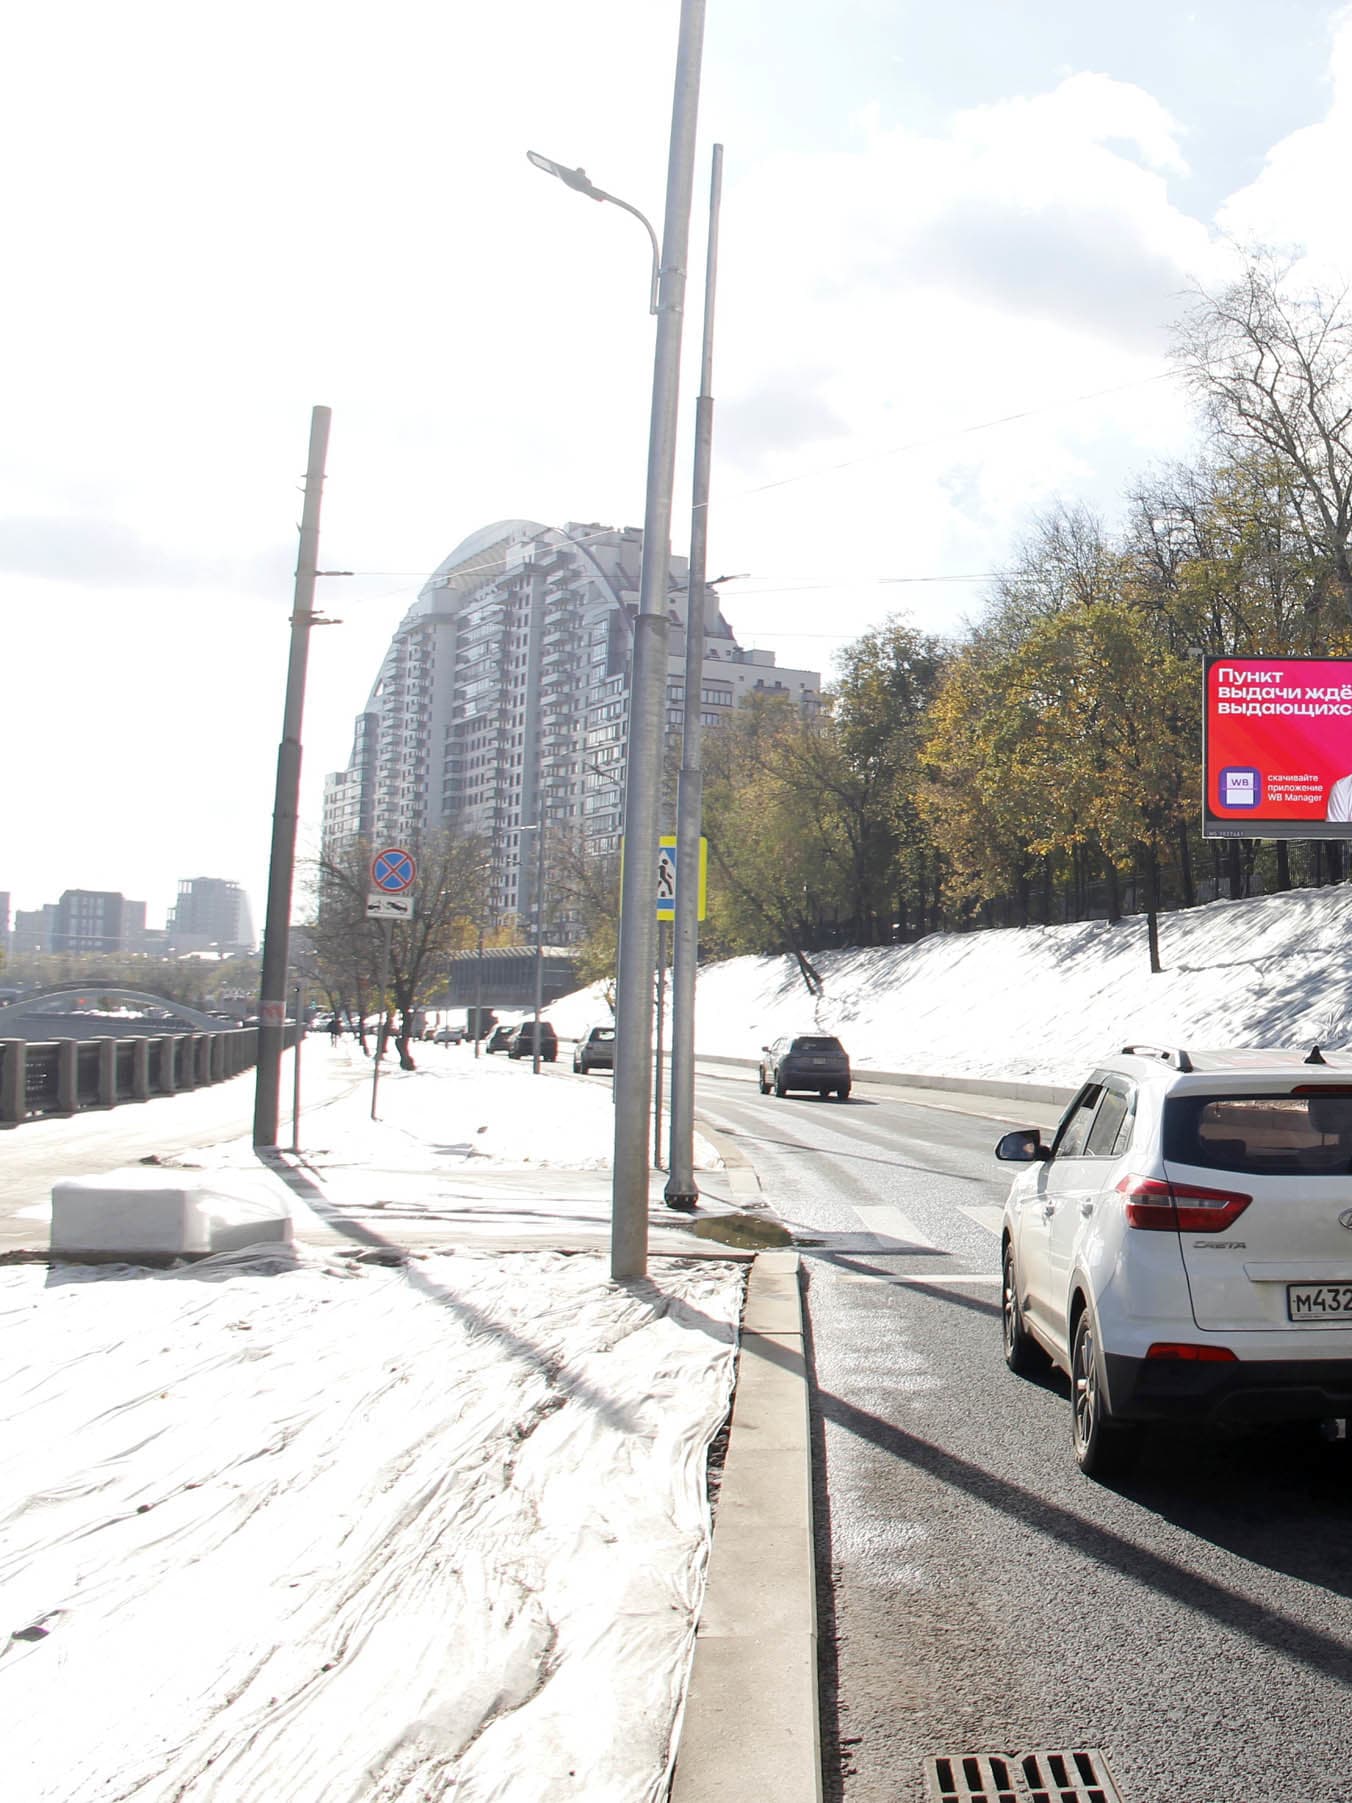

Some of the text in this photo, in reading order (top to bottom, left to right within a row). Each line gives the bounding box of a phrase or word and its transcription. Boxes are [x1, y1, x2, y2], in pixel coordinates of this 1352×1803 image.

[1218, 668, 1284, 685] Пункт
[1218, 686, 1302, 700] выдачи
[1231, 778, 1249, 786] WB
[1267, 774, 1319, 782] скачивайте
[1267, 784, 1323, 792] приложение
[1268, 793, 1322, 804] WB Manager
